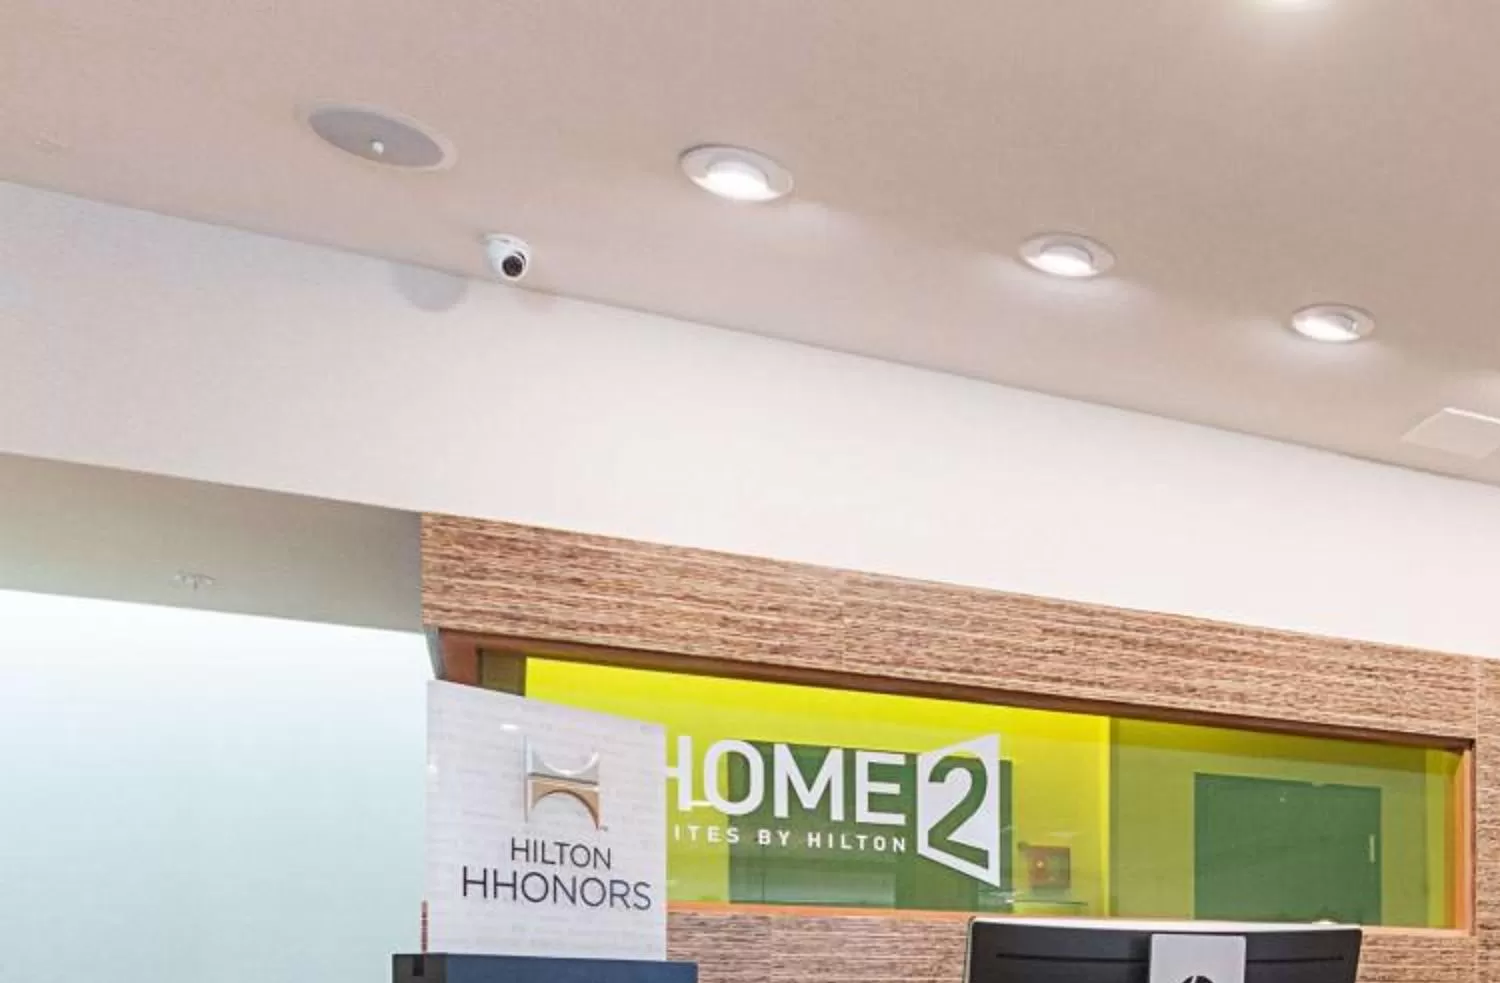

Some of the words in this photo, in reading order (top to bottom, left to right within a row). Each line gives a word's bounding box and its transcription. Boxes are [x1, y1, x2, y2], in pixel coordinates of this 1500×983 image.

[925, 746, 993, 874] 2
[511, 836, 612, 871] HILTON
[674, 824, 740, 844] ITES
[758, 828, 791, 846] BY
[807, 831, 906, 853] HILTON
[462, 865, 652, 911] HHONORS
